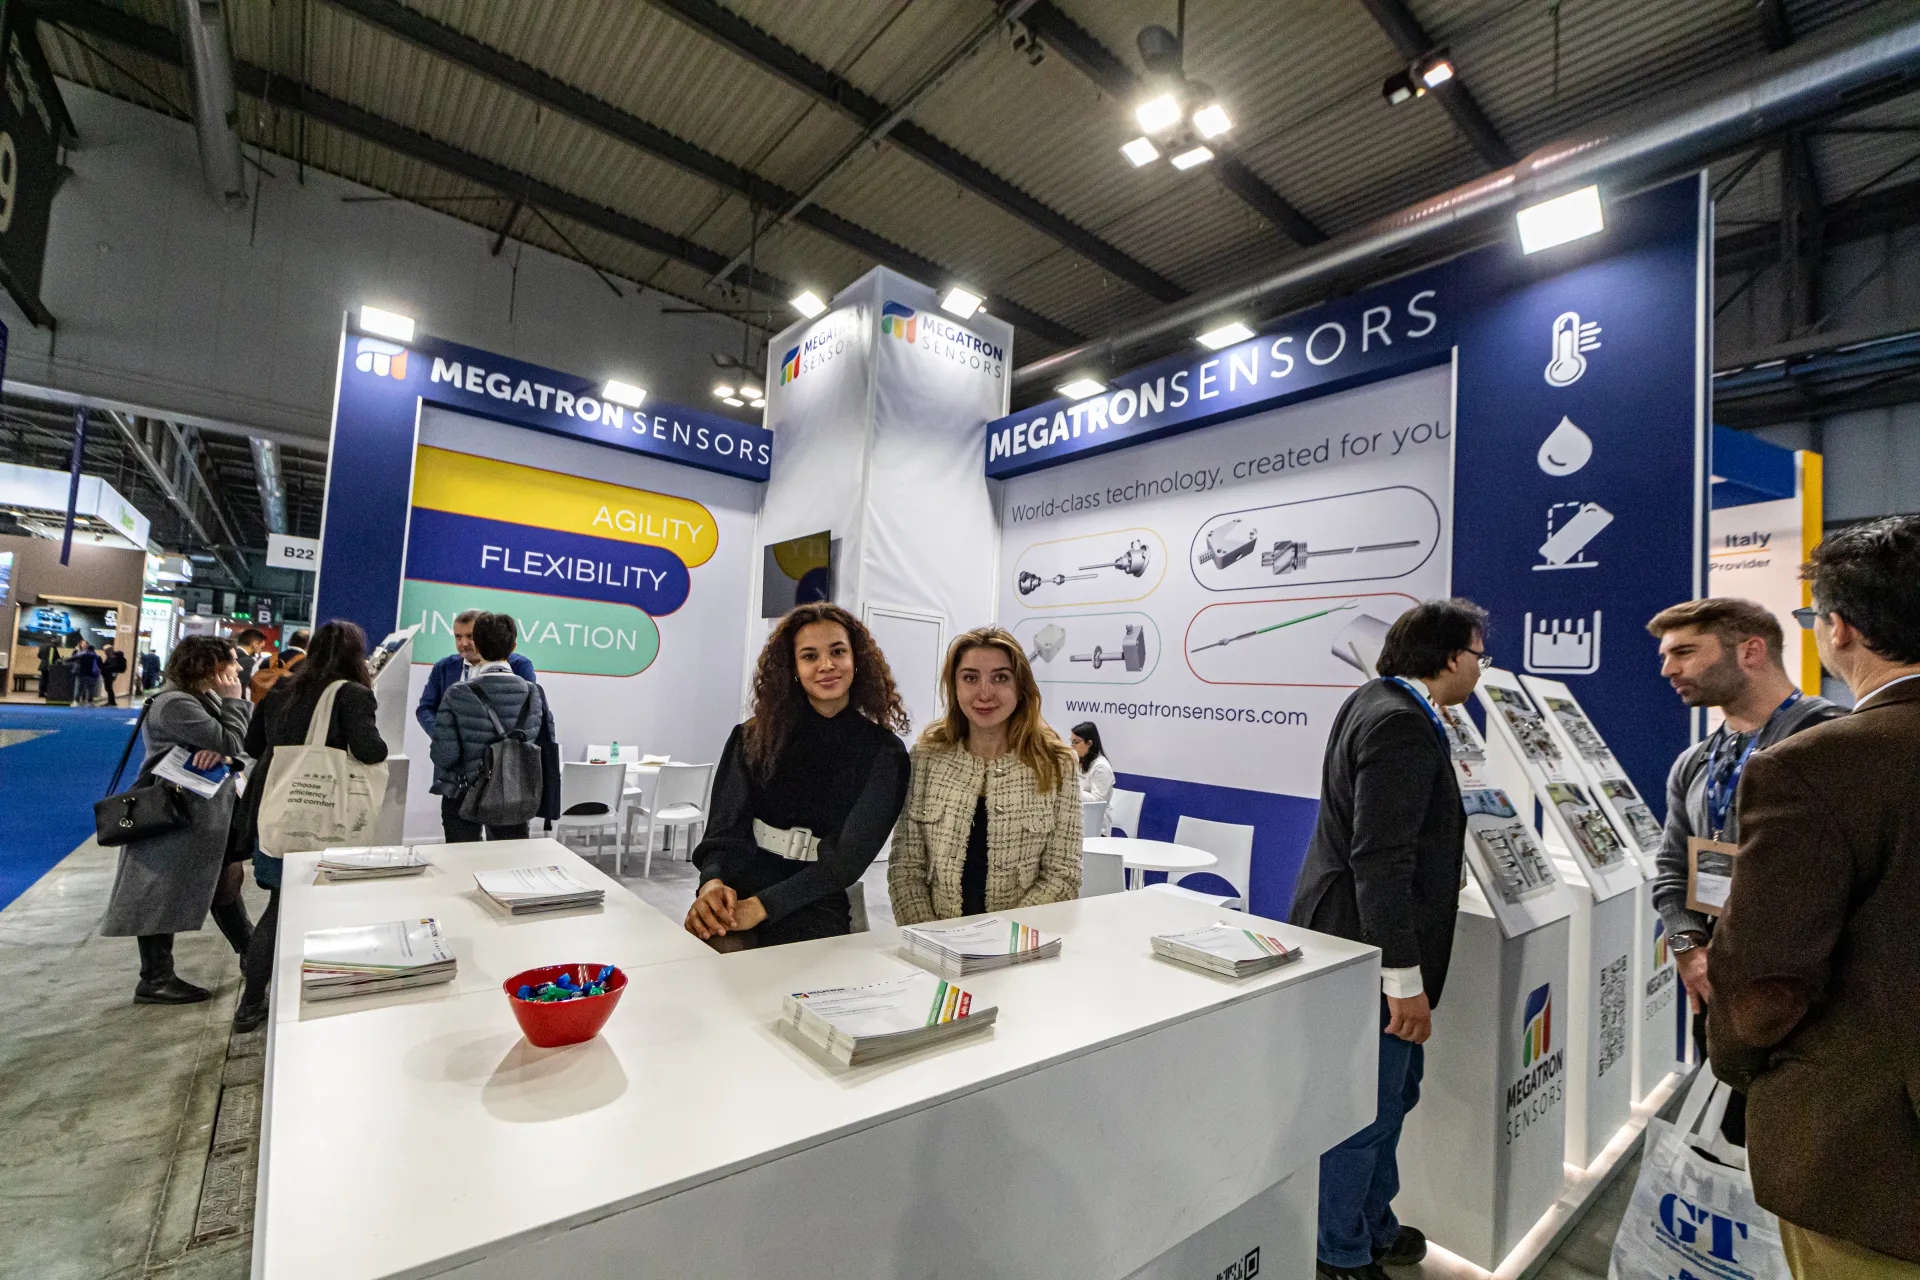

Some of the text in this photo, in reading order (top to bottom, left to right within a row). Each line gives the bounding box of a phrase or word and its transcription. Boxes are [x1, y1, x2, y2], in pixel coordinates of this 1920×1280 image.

[803, 330, 862, 374] SENSOR
[804, 305, 864, 355] MEGAN
[924, 316, 1003, 362] MEGATRON
[923, 336, 1002, 378] SENSORS
[989, 290, 1437, 462] MEGATRON SENSORS
[430, 356, 770, 466] MEGATRON SENSORS
[1012, 420, 1451, 522] World-class technology, created for you
[592, 506, 704, 544] AGILITY
[1725, 531, 1772, 548] Italy
[283, 546, 315, 560] B22
[481, 545, 667, 592] FLEXIBILITY
[1709, 559, 1772, 571] Provider
[420, 608, 637, 652] INVATION
[1066, 700, 1308, 726] www.megatronsensors.com
[289, 790, 328, 799] efficiency
[292, 781, 321, 790] Choose
[303, 799, 335, 808] comfort
[1506, 1048, 1563, 1114] MEGATRON
[1506, 1080, 1562, 1145] SENSORS
[1660, 1193, 1748, 1264] GT
